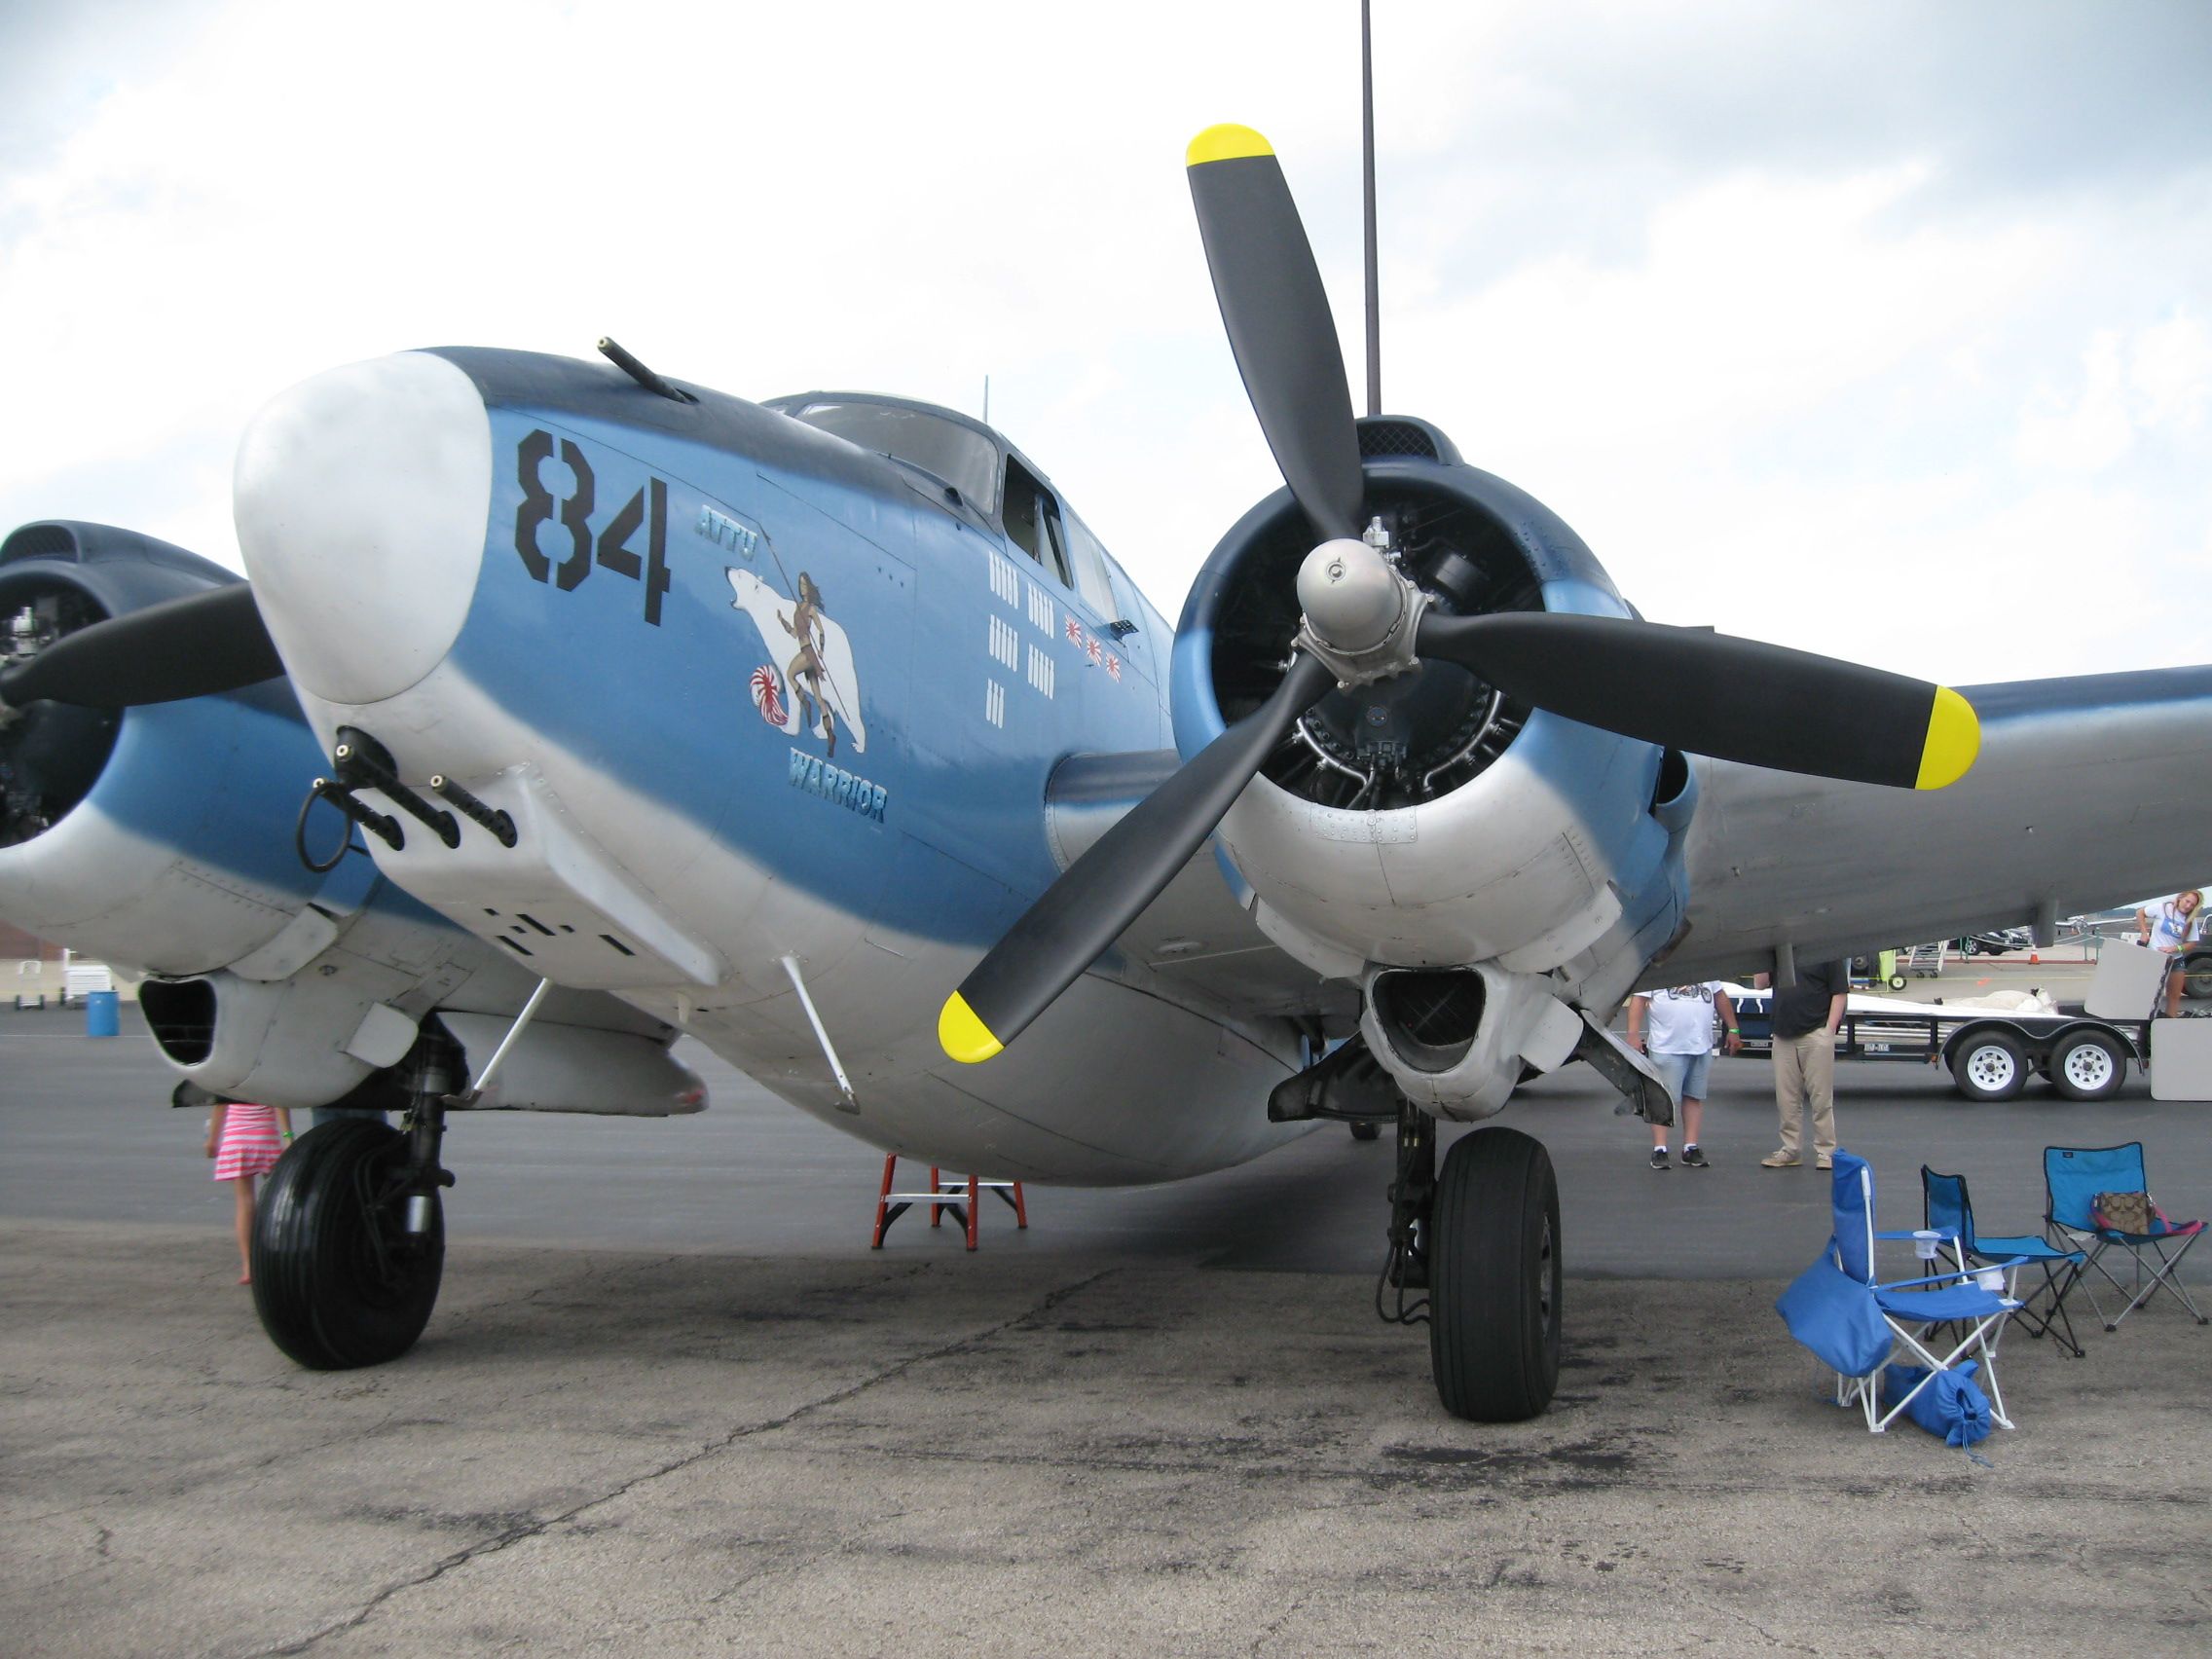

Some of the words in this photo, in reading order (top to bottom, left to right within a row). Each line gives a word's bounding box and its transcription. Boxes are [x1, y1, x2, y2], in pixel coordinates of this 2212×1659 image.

[515, 428, 671, 627] 84
[695, 504, 757, 561] ATTU
[789, 747, 888, 824] WARRIOR
